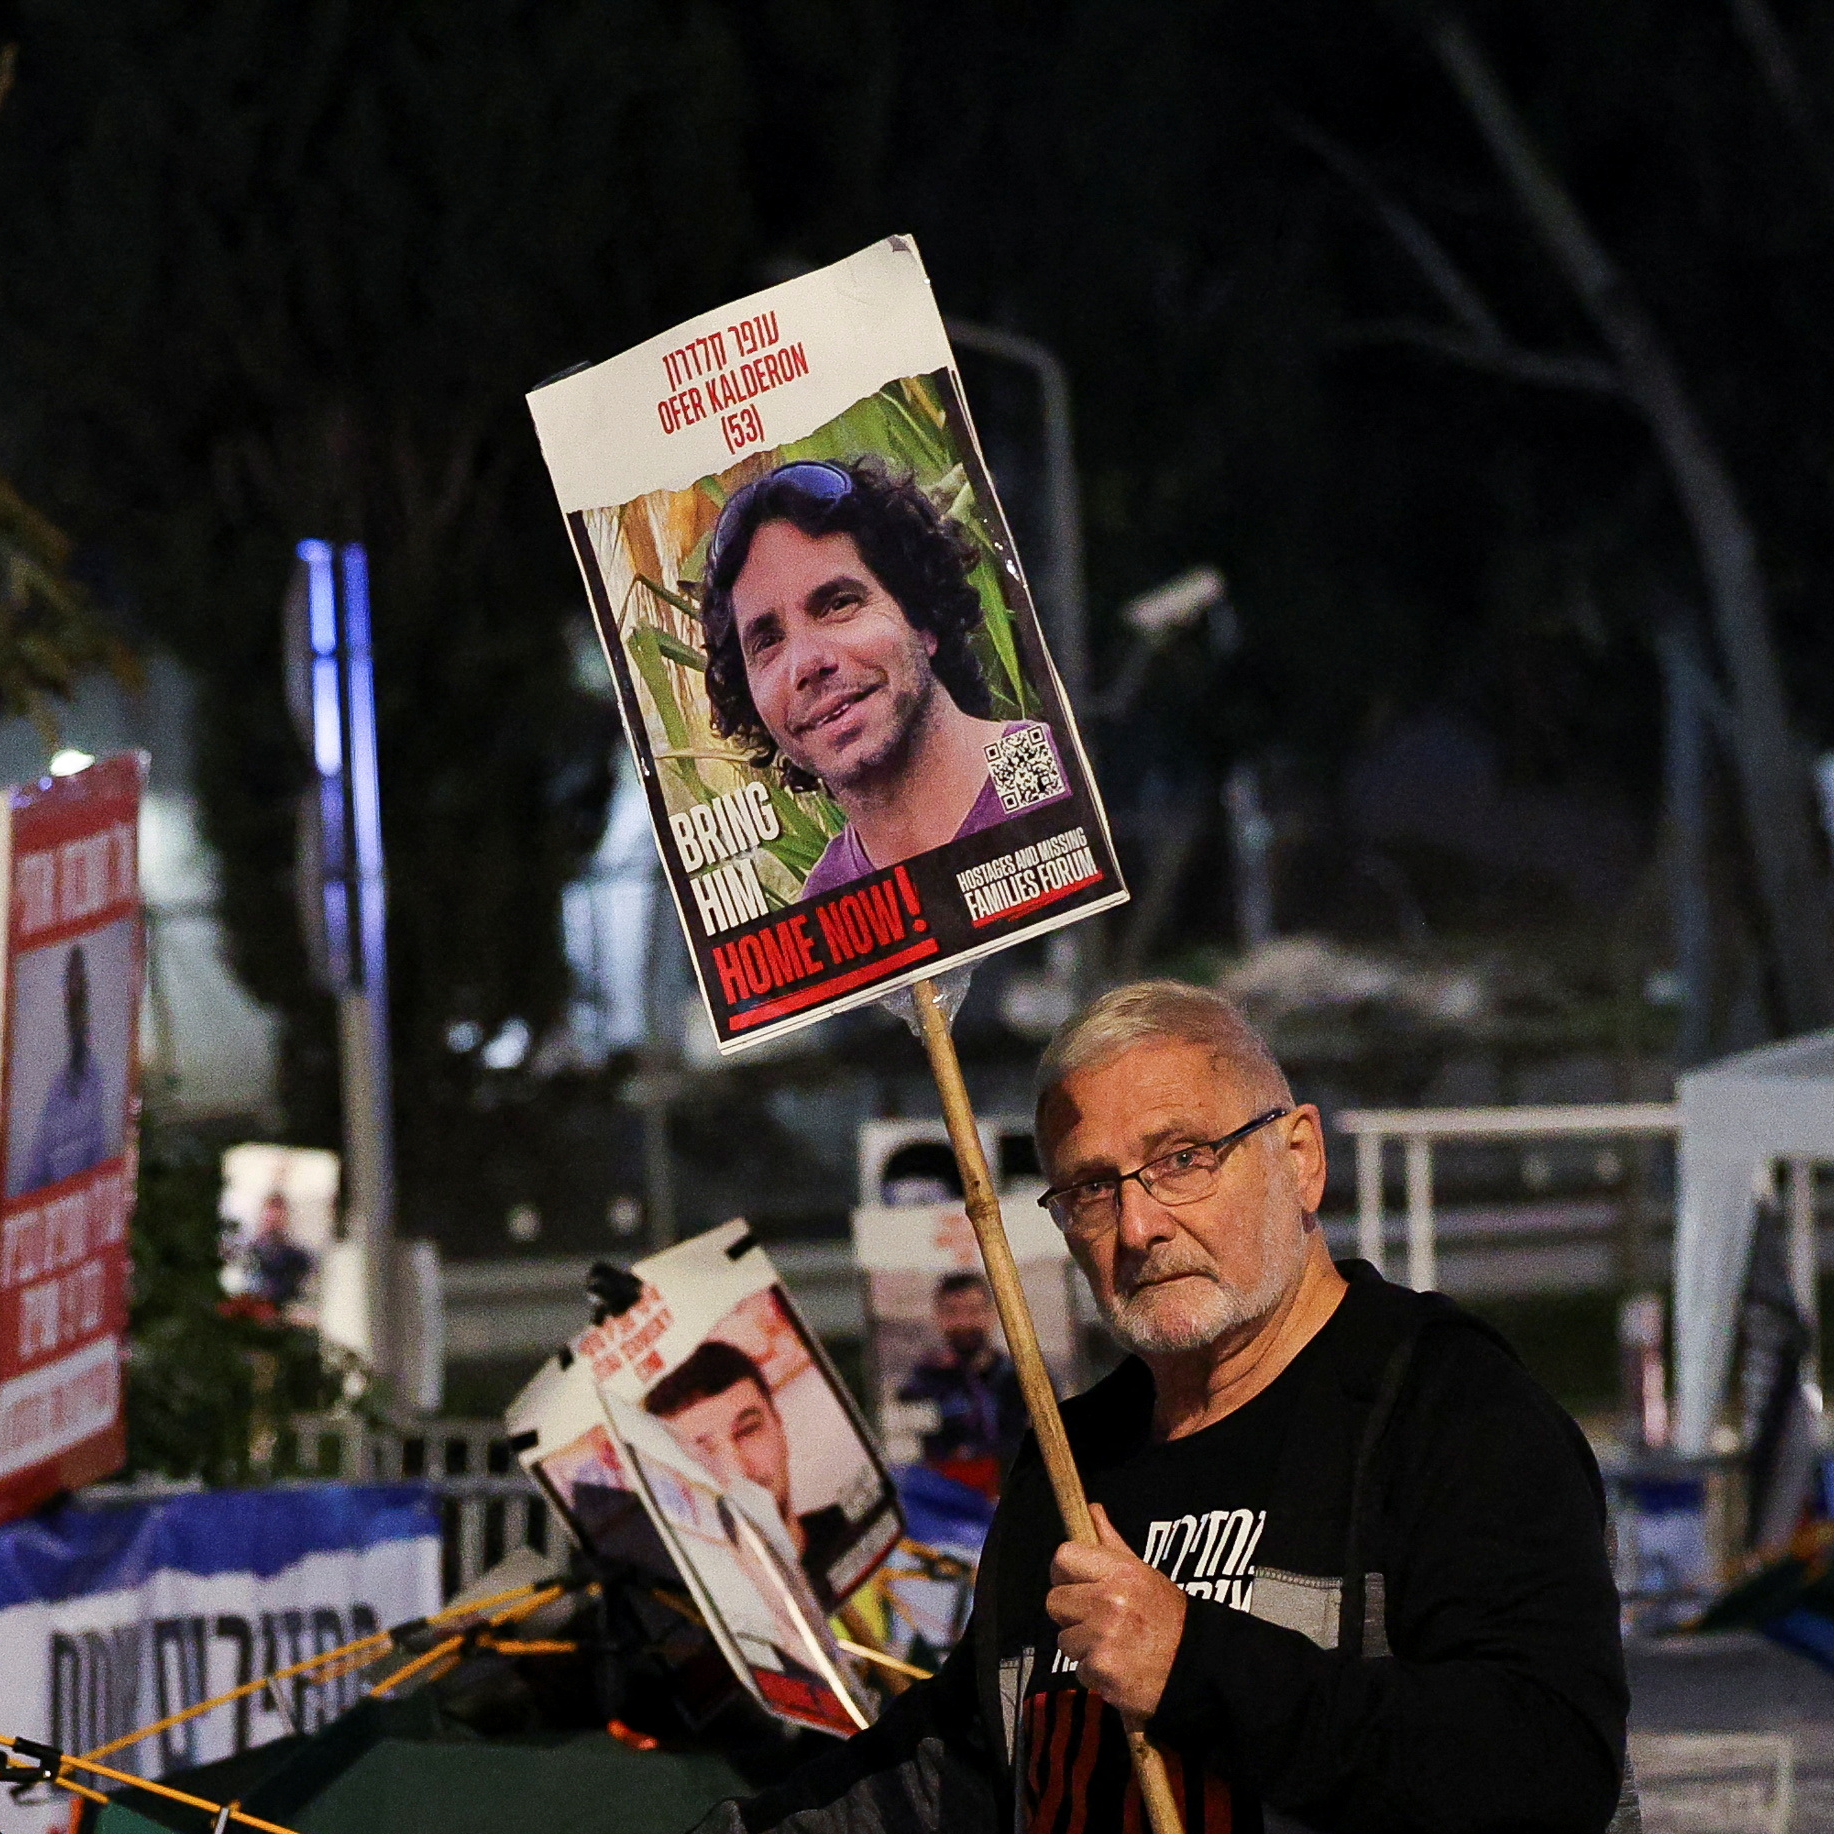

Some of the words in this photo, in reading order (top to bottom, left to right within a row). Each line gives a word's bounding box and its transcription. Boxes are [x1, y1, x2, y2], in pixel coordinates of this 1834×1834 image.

[662, 331, 728, 393] קלדרון
[727, 310, 780, 357] עופר
[657, 387, 708, 435] OFER
[705, 341, 810, 415] KALDERON
[720, 403, 766, 455] (53)
[669, 781, 781, 874] BRING
[956, 854, 1017, 894] HOSTAGES
[1014, 845, 1040, 872] AND
[1036, 826, 1088, 862] MISSING
[688, 858, 769, 937] HIM
[963, 869, 1041, 922] FAMILIES
[1037, 846, 1098, 894] FORUM
[713, 914, 824, 1005] HOME
[815, 865, 928, 965] NOW!
